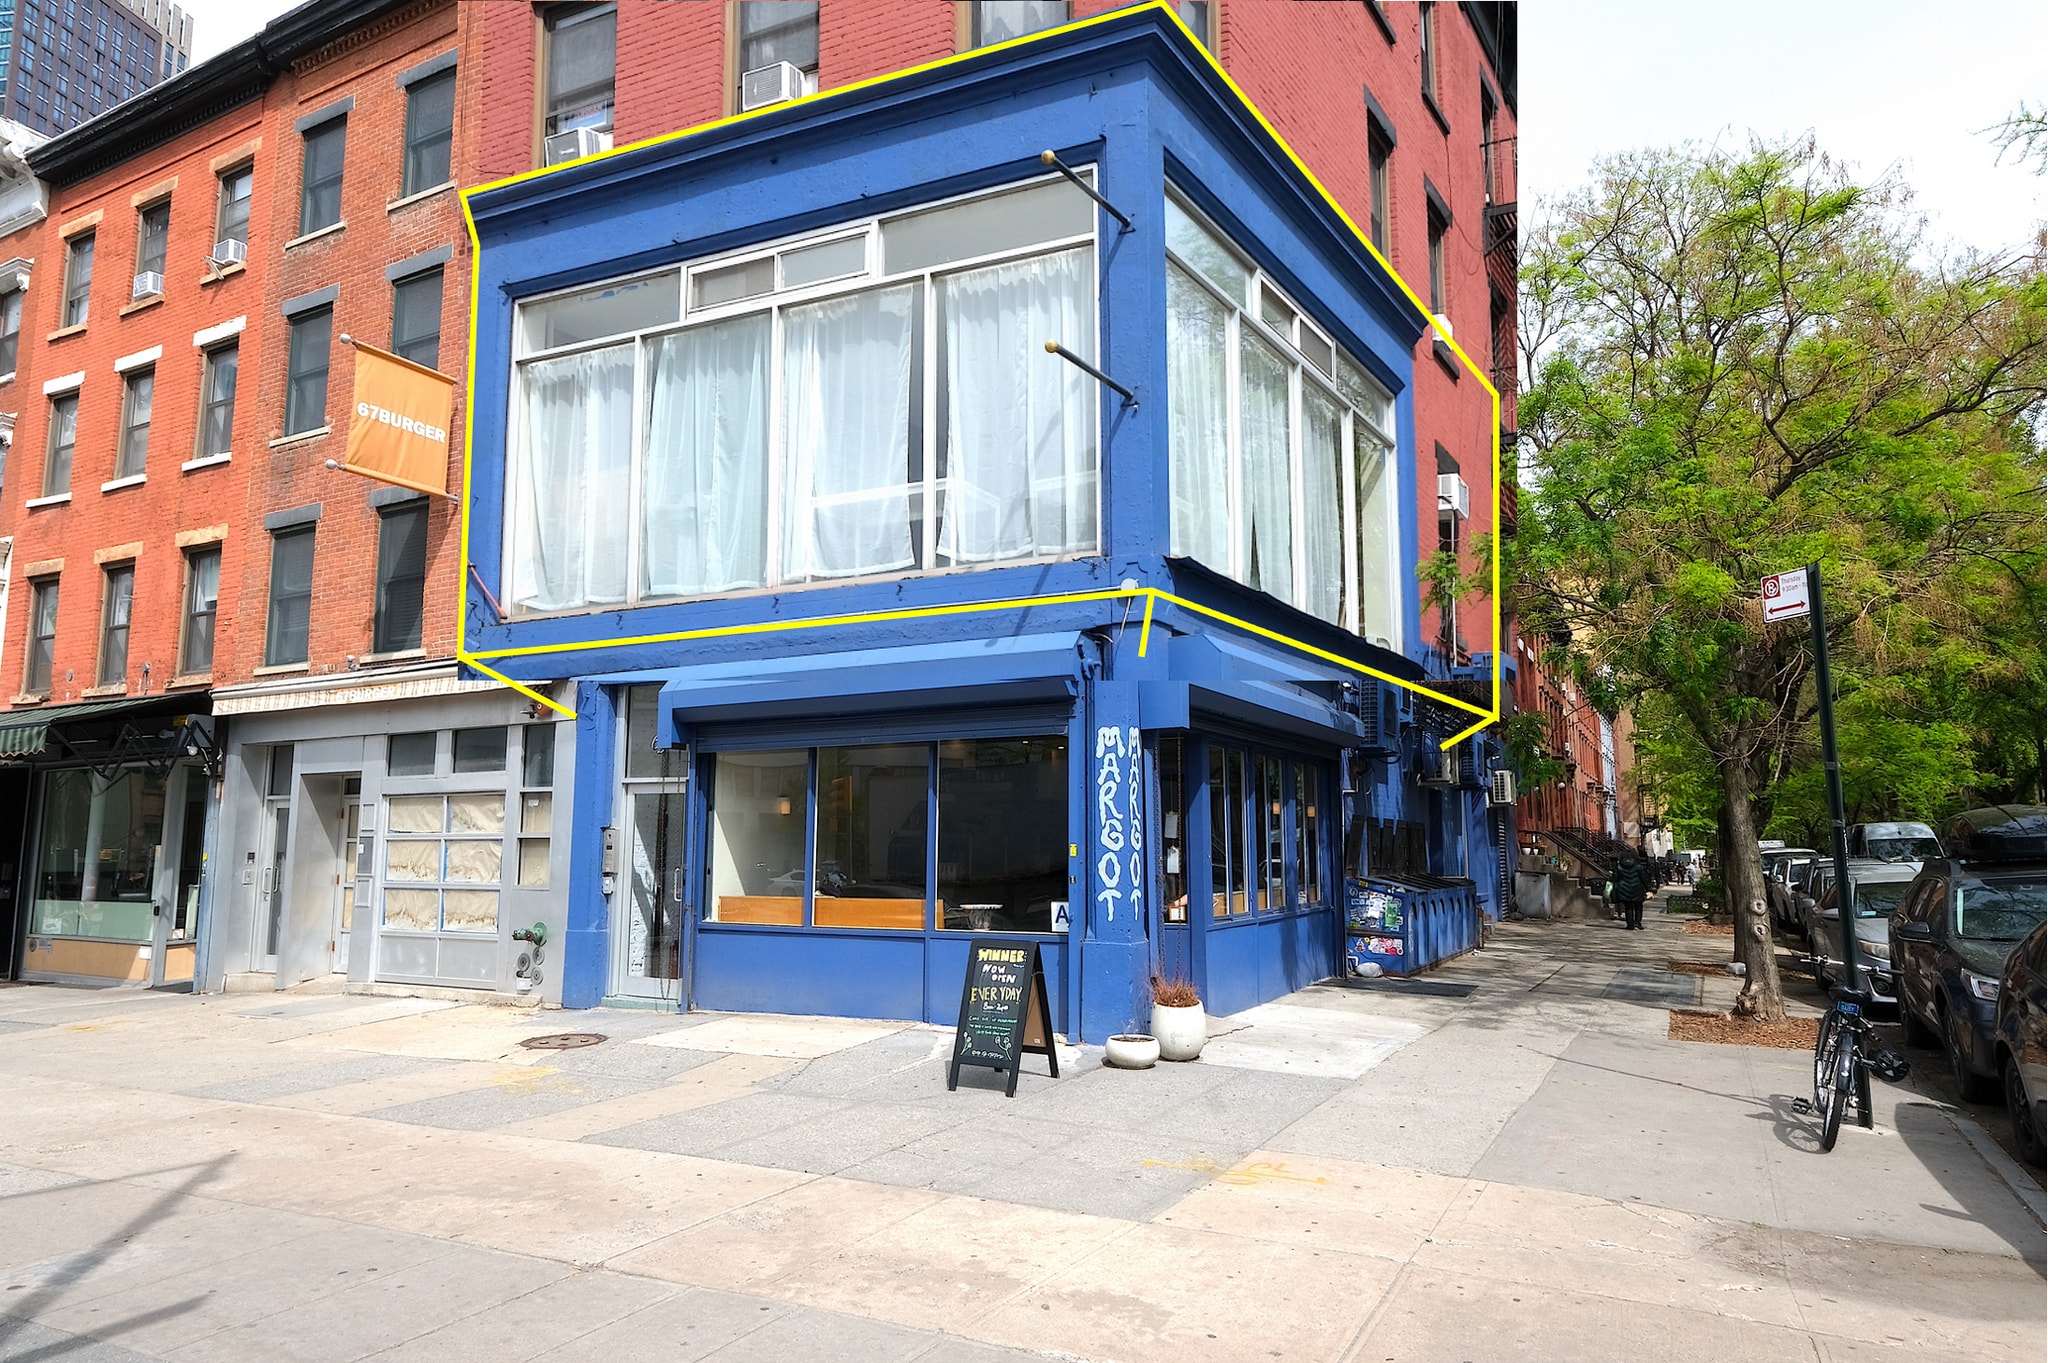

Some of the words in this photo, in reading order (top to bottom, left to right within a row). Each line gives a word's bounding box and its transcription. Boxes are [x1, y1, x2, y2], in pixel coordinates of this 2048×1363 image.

[357, 402, 446, 443] 67BURGER
[336, 686, 394, 702] 67BURGER
[1096, 726, 1125, 922] MARGOT
[1128, 727, 1142, 921] MARGOT
[1055, 905, 1069, 923] A
[978, 948, 1025, 963] WINNER
[982, 964, 1006, 974] NOW
[991, 974, 1016, 984] OPEN
